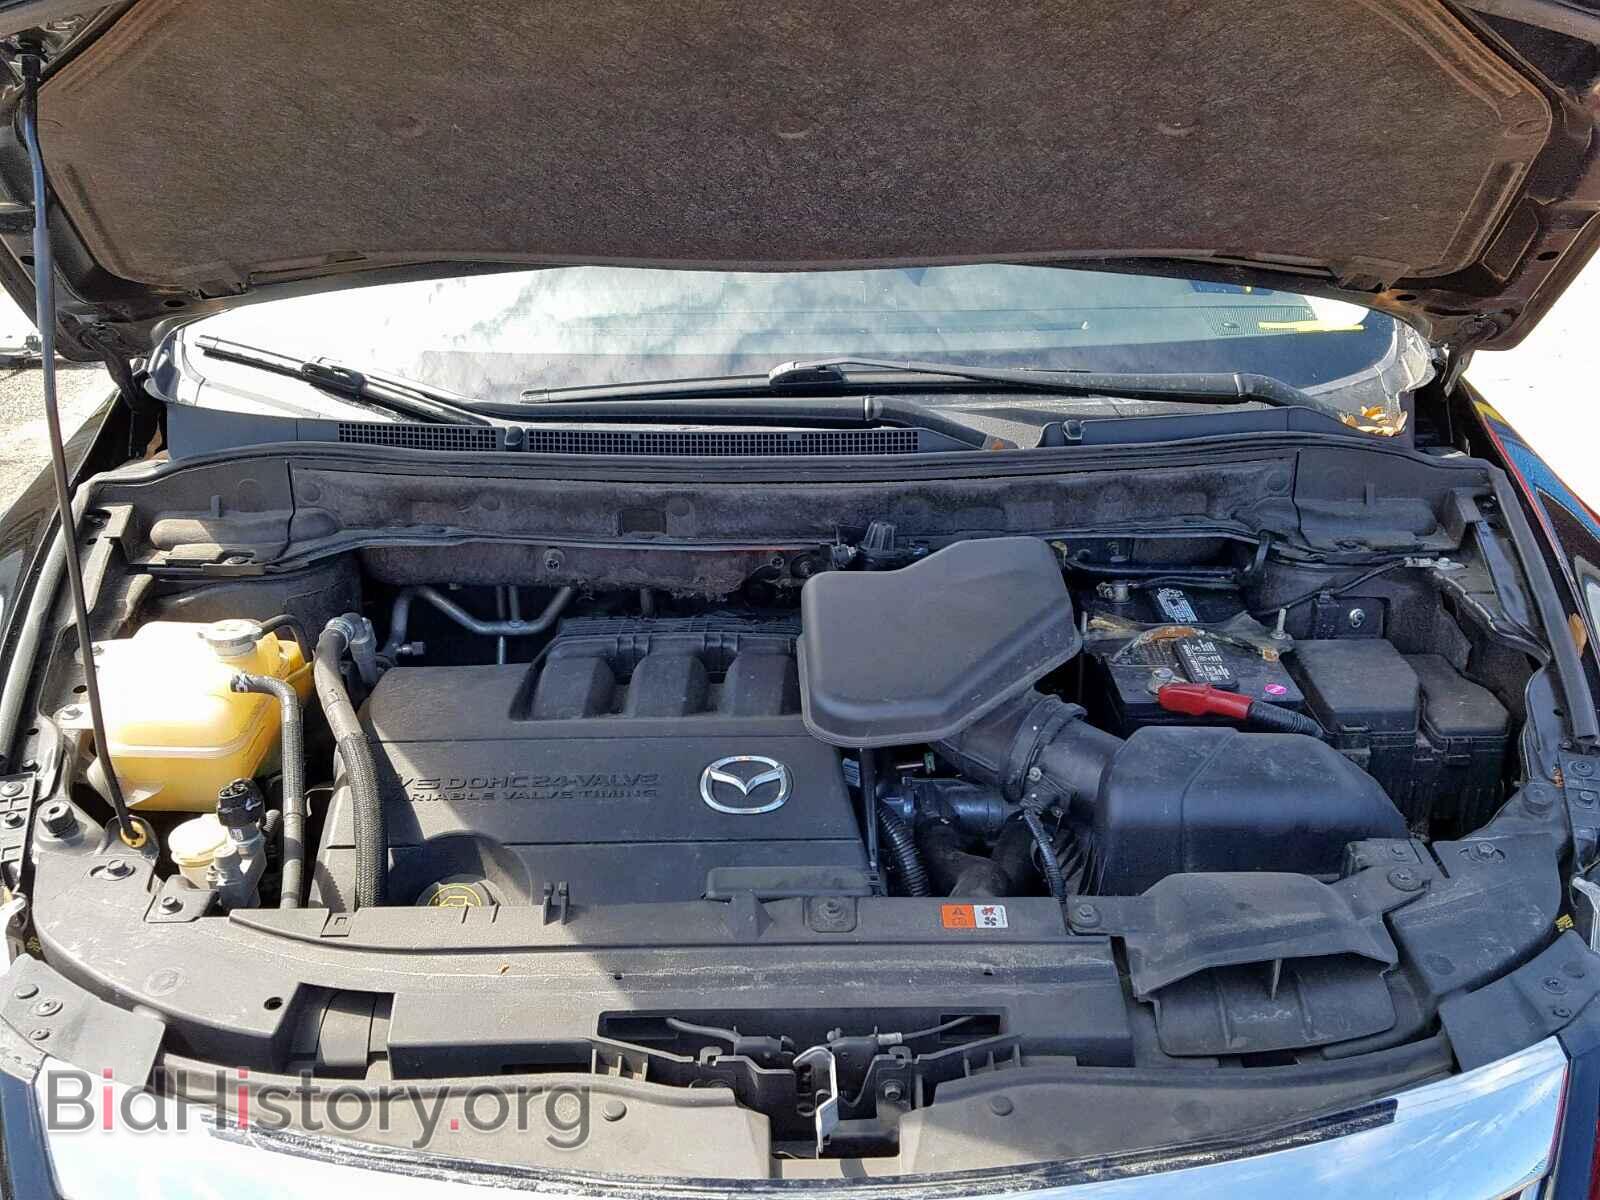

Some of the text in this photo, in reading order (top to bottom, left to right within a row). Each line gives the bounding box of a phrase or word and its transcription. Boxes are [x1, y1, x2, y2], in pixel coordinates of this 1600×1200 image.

[444, 775, 530, 790] DOHC
[531, 773, 661, 788] 24-VALVE
[502, 790, 575, 801] VALVE
